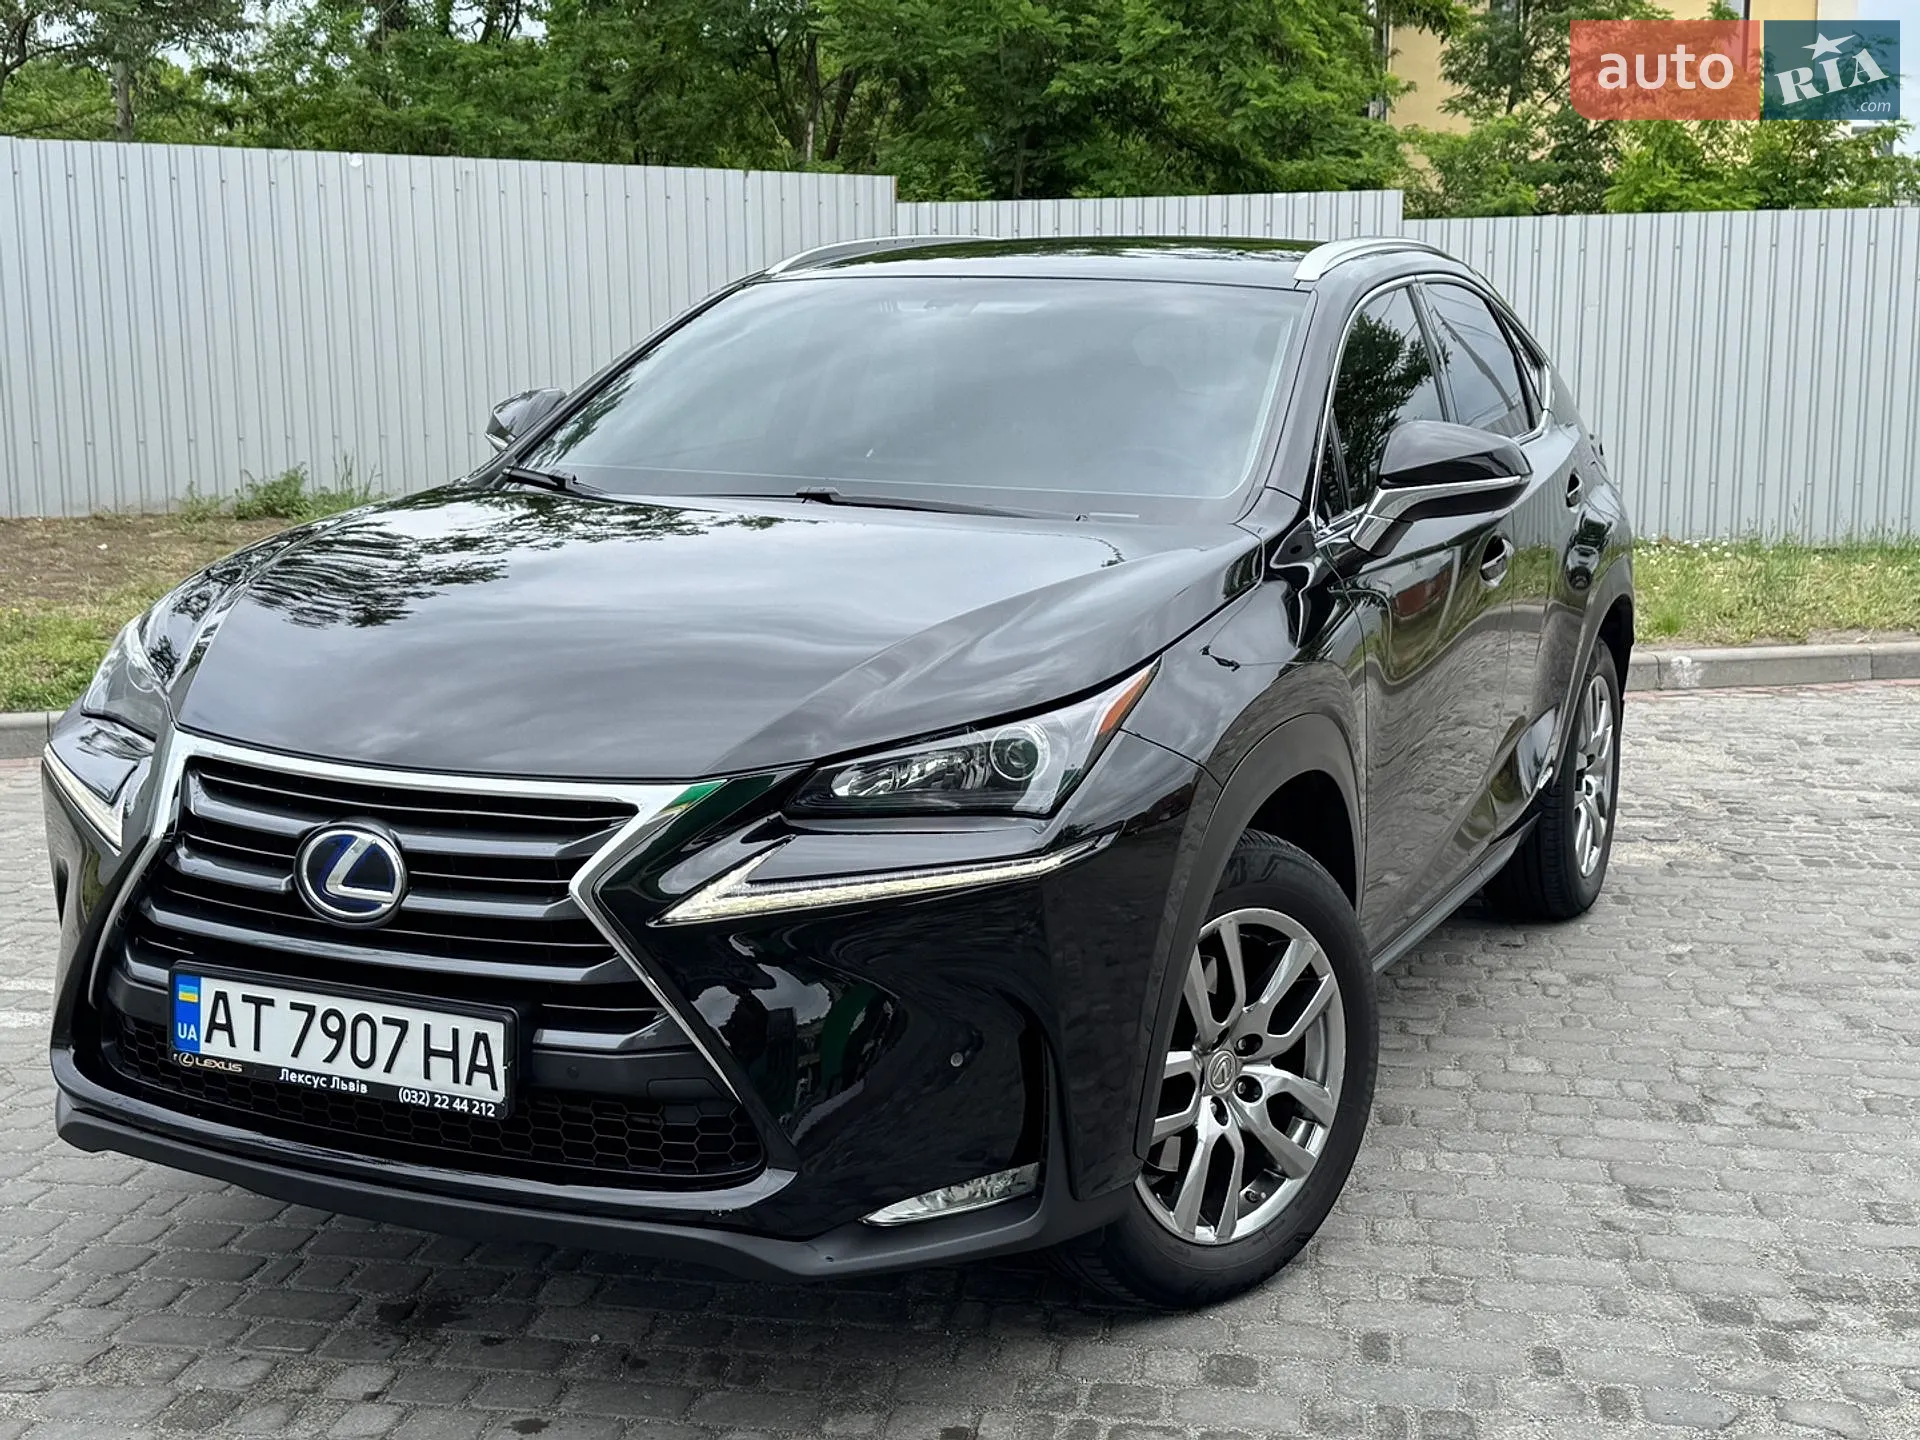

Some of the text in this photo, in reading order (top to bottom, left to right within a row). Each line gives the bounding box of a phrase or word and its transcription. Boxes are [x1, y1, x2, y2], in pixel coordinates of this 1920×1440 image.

[177, 1022, 198, 1042] UA
[204, 990, 498, 1093] AT 7907 HA
[195, 1058, 243, 1073] LEXUS
[279, 1068, 368, 1094] Лексус Львів
[398, 1087, 496, 1118] (032) 22 44 212
